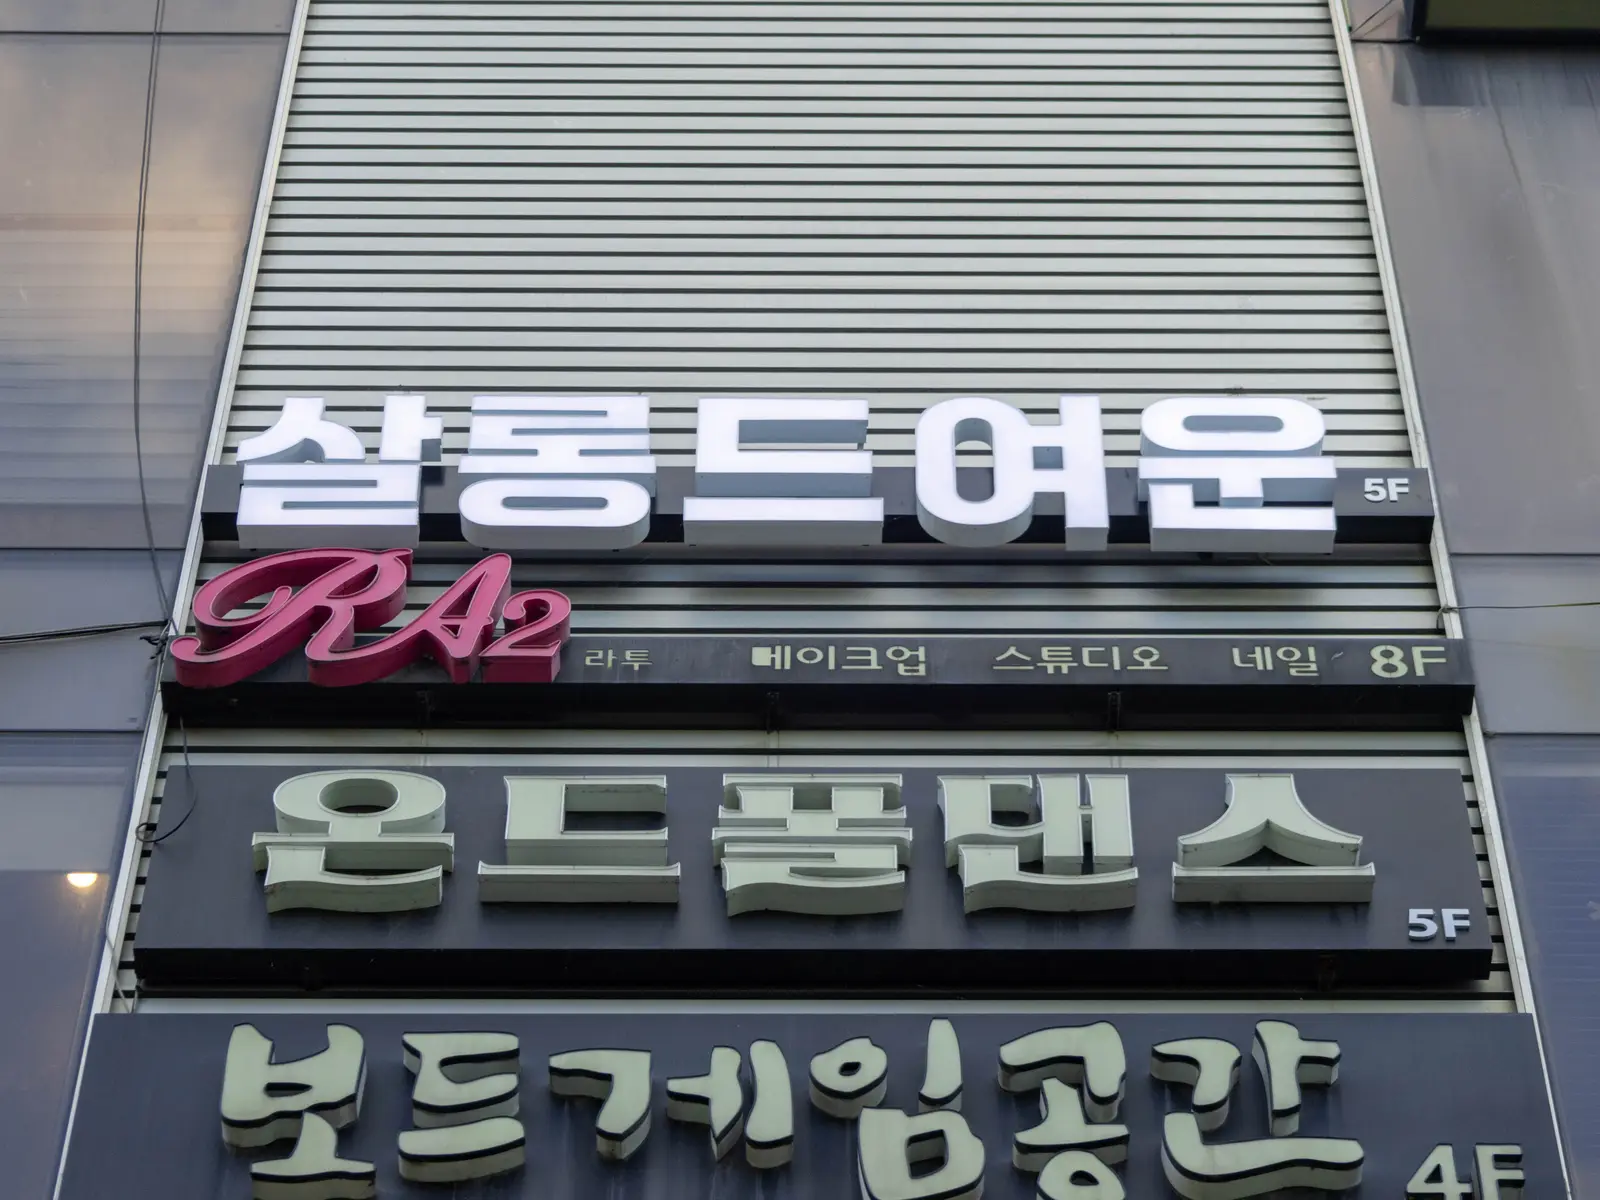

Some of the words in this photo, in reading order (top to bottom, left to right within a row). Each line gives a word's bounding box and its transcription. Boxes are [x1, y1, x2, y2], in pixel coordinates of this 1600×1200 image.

[236, 395, 1337, 551] 살롱드여운
[1364, 477, 1409, 503] 5F
[170, 548, 572, 687] RA2
[585, 649, 653, 671] 라투
[751, 645, 926, 676] 메이크업
[992, 645, 1168, 674] 스튜디오
[1232, 645, 1320, 677] 네일
[1370, 645, 1447, 678] 8F
[251, 769, 1376, 917] 온드폴댄스
[1408, 908, 1471, 941] 5F
[218, 1017, 1364, 1200] 보드게임공간
[1404, 1143, 1525, 1200] 4F
